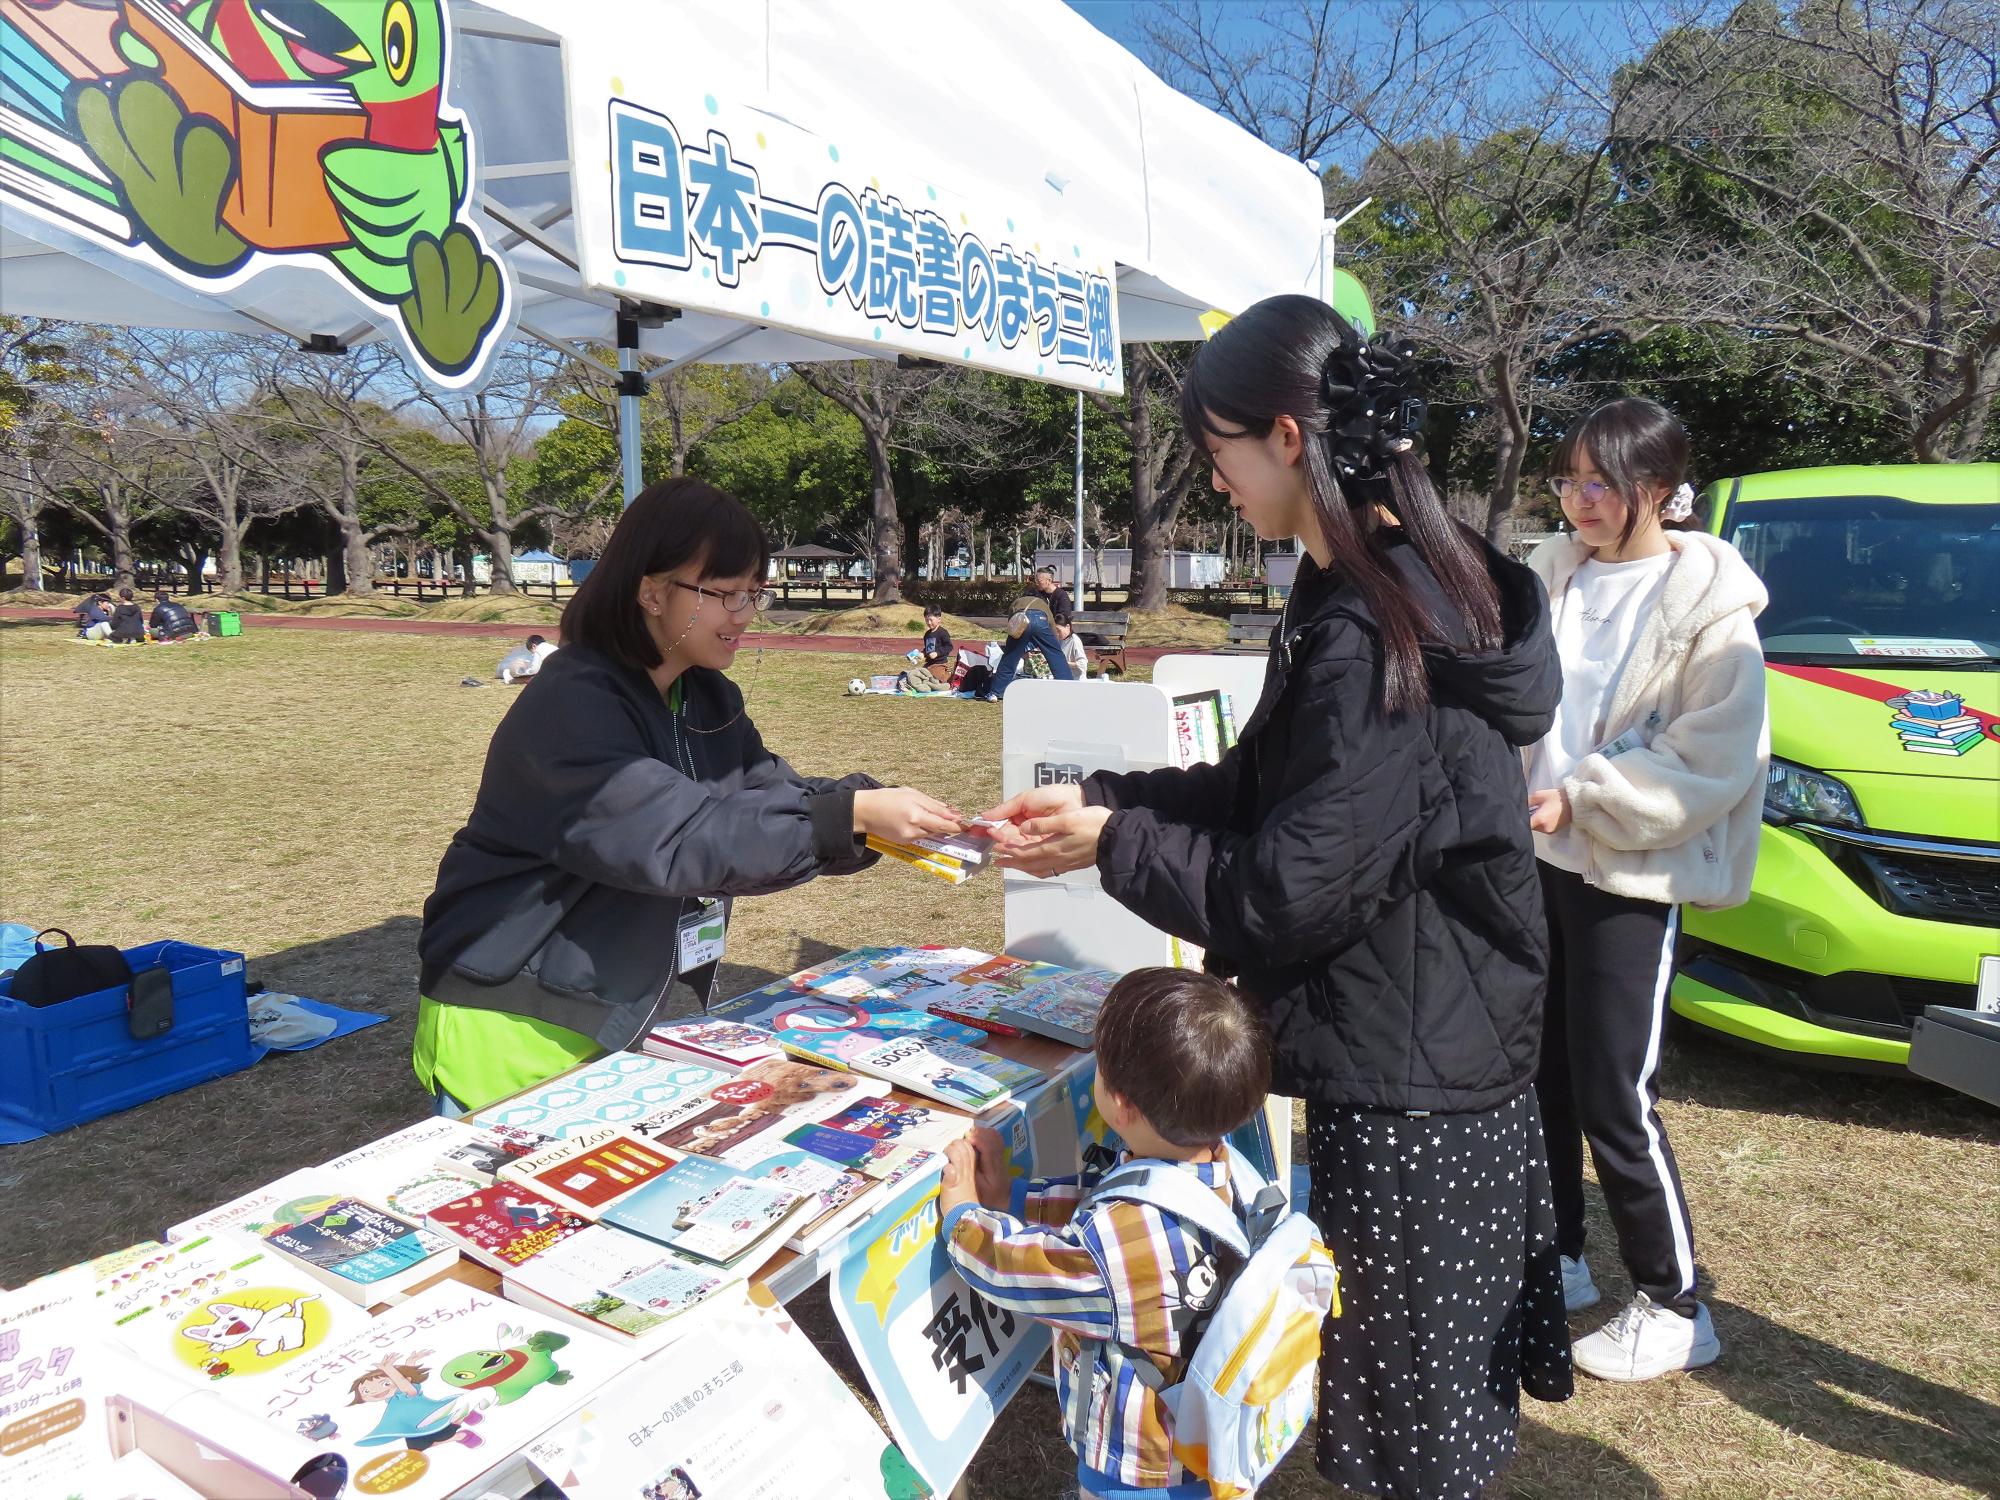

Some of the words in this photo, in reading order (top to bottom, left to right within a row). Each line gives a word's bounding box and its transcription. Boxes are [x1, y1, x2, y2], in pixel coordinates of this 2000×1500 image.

[608, 97, 1116, 374] 日本一の読書のまち三郷
[513, 1146, 572, 1175] Dear
[571, 1128, 615, 1149] Zoo
[369, 1297, 493, 1350] さつきちゃん
[628, 1360, 744, 1448] 日本一の読書のまち三郷
